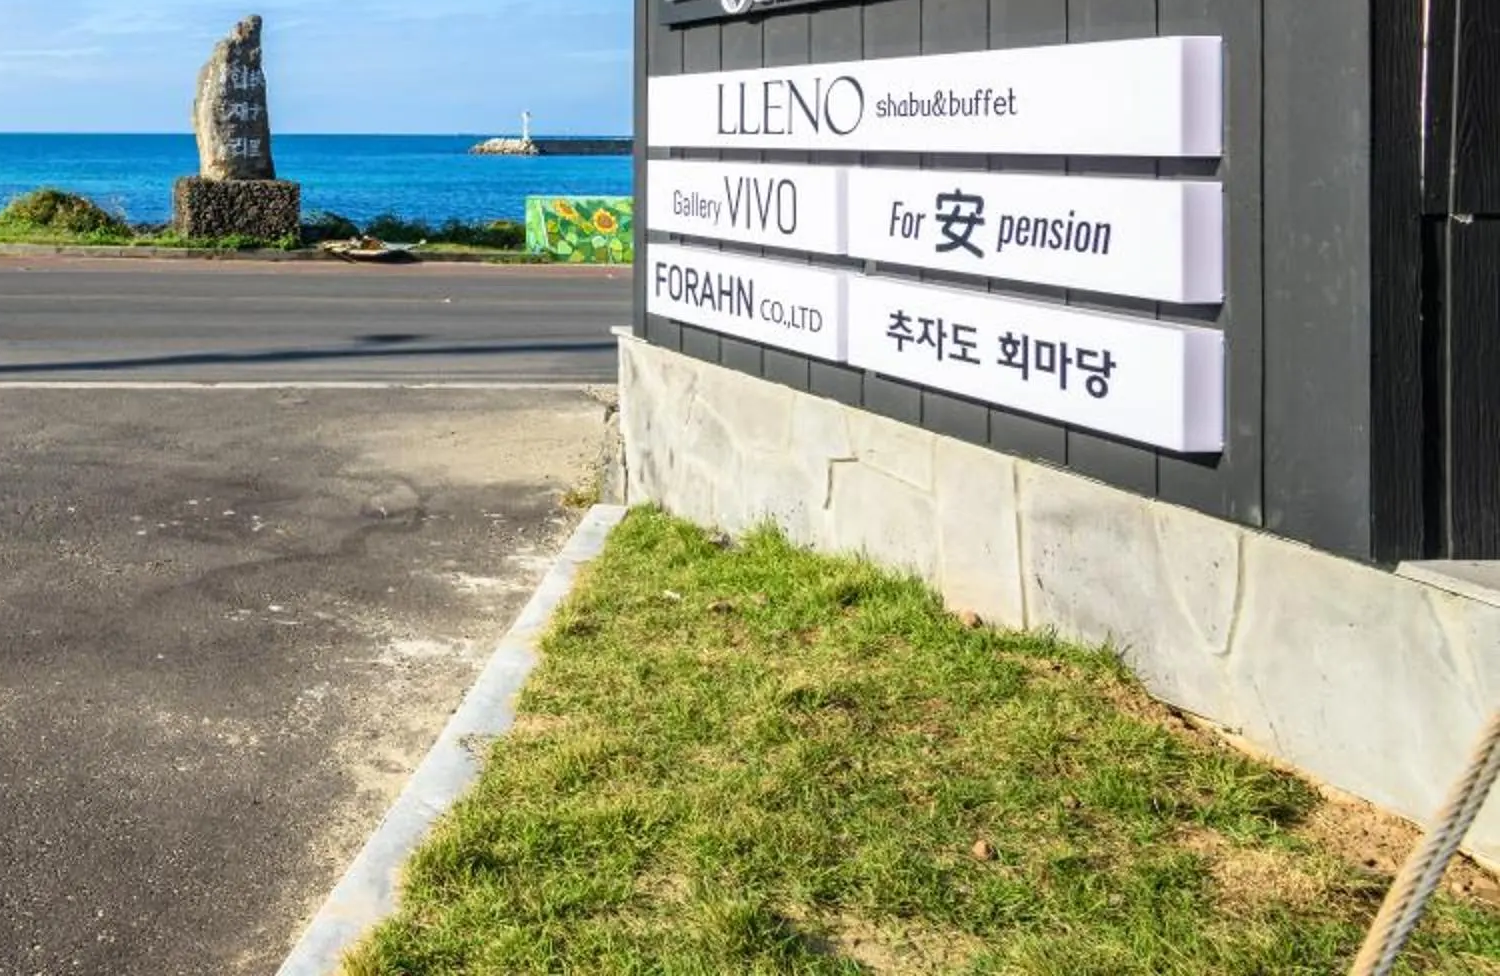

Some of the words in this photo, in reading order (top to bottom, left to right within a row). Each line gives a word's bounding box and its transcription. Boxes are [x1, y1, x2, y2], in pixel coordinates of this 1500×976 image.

[717, 75, 865, 136] LLENO
[876, 87, 1017, 117] shabu&buffet
[673, 189, 721, 226] Gallery
[724, 176, 797, 235] VIVO
[889, 201, 926, 240] For
[935, 188, 985, 259] 安
[997, 210, 1111, 255] pension
[655, 261, 754, 320] FORAHN
[886, 309, 981, 365] 추자도
[996, 331, 1117, 399] 회마당
